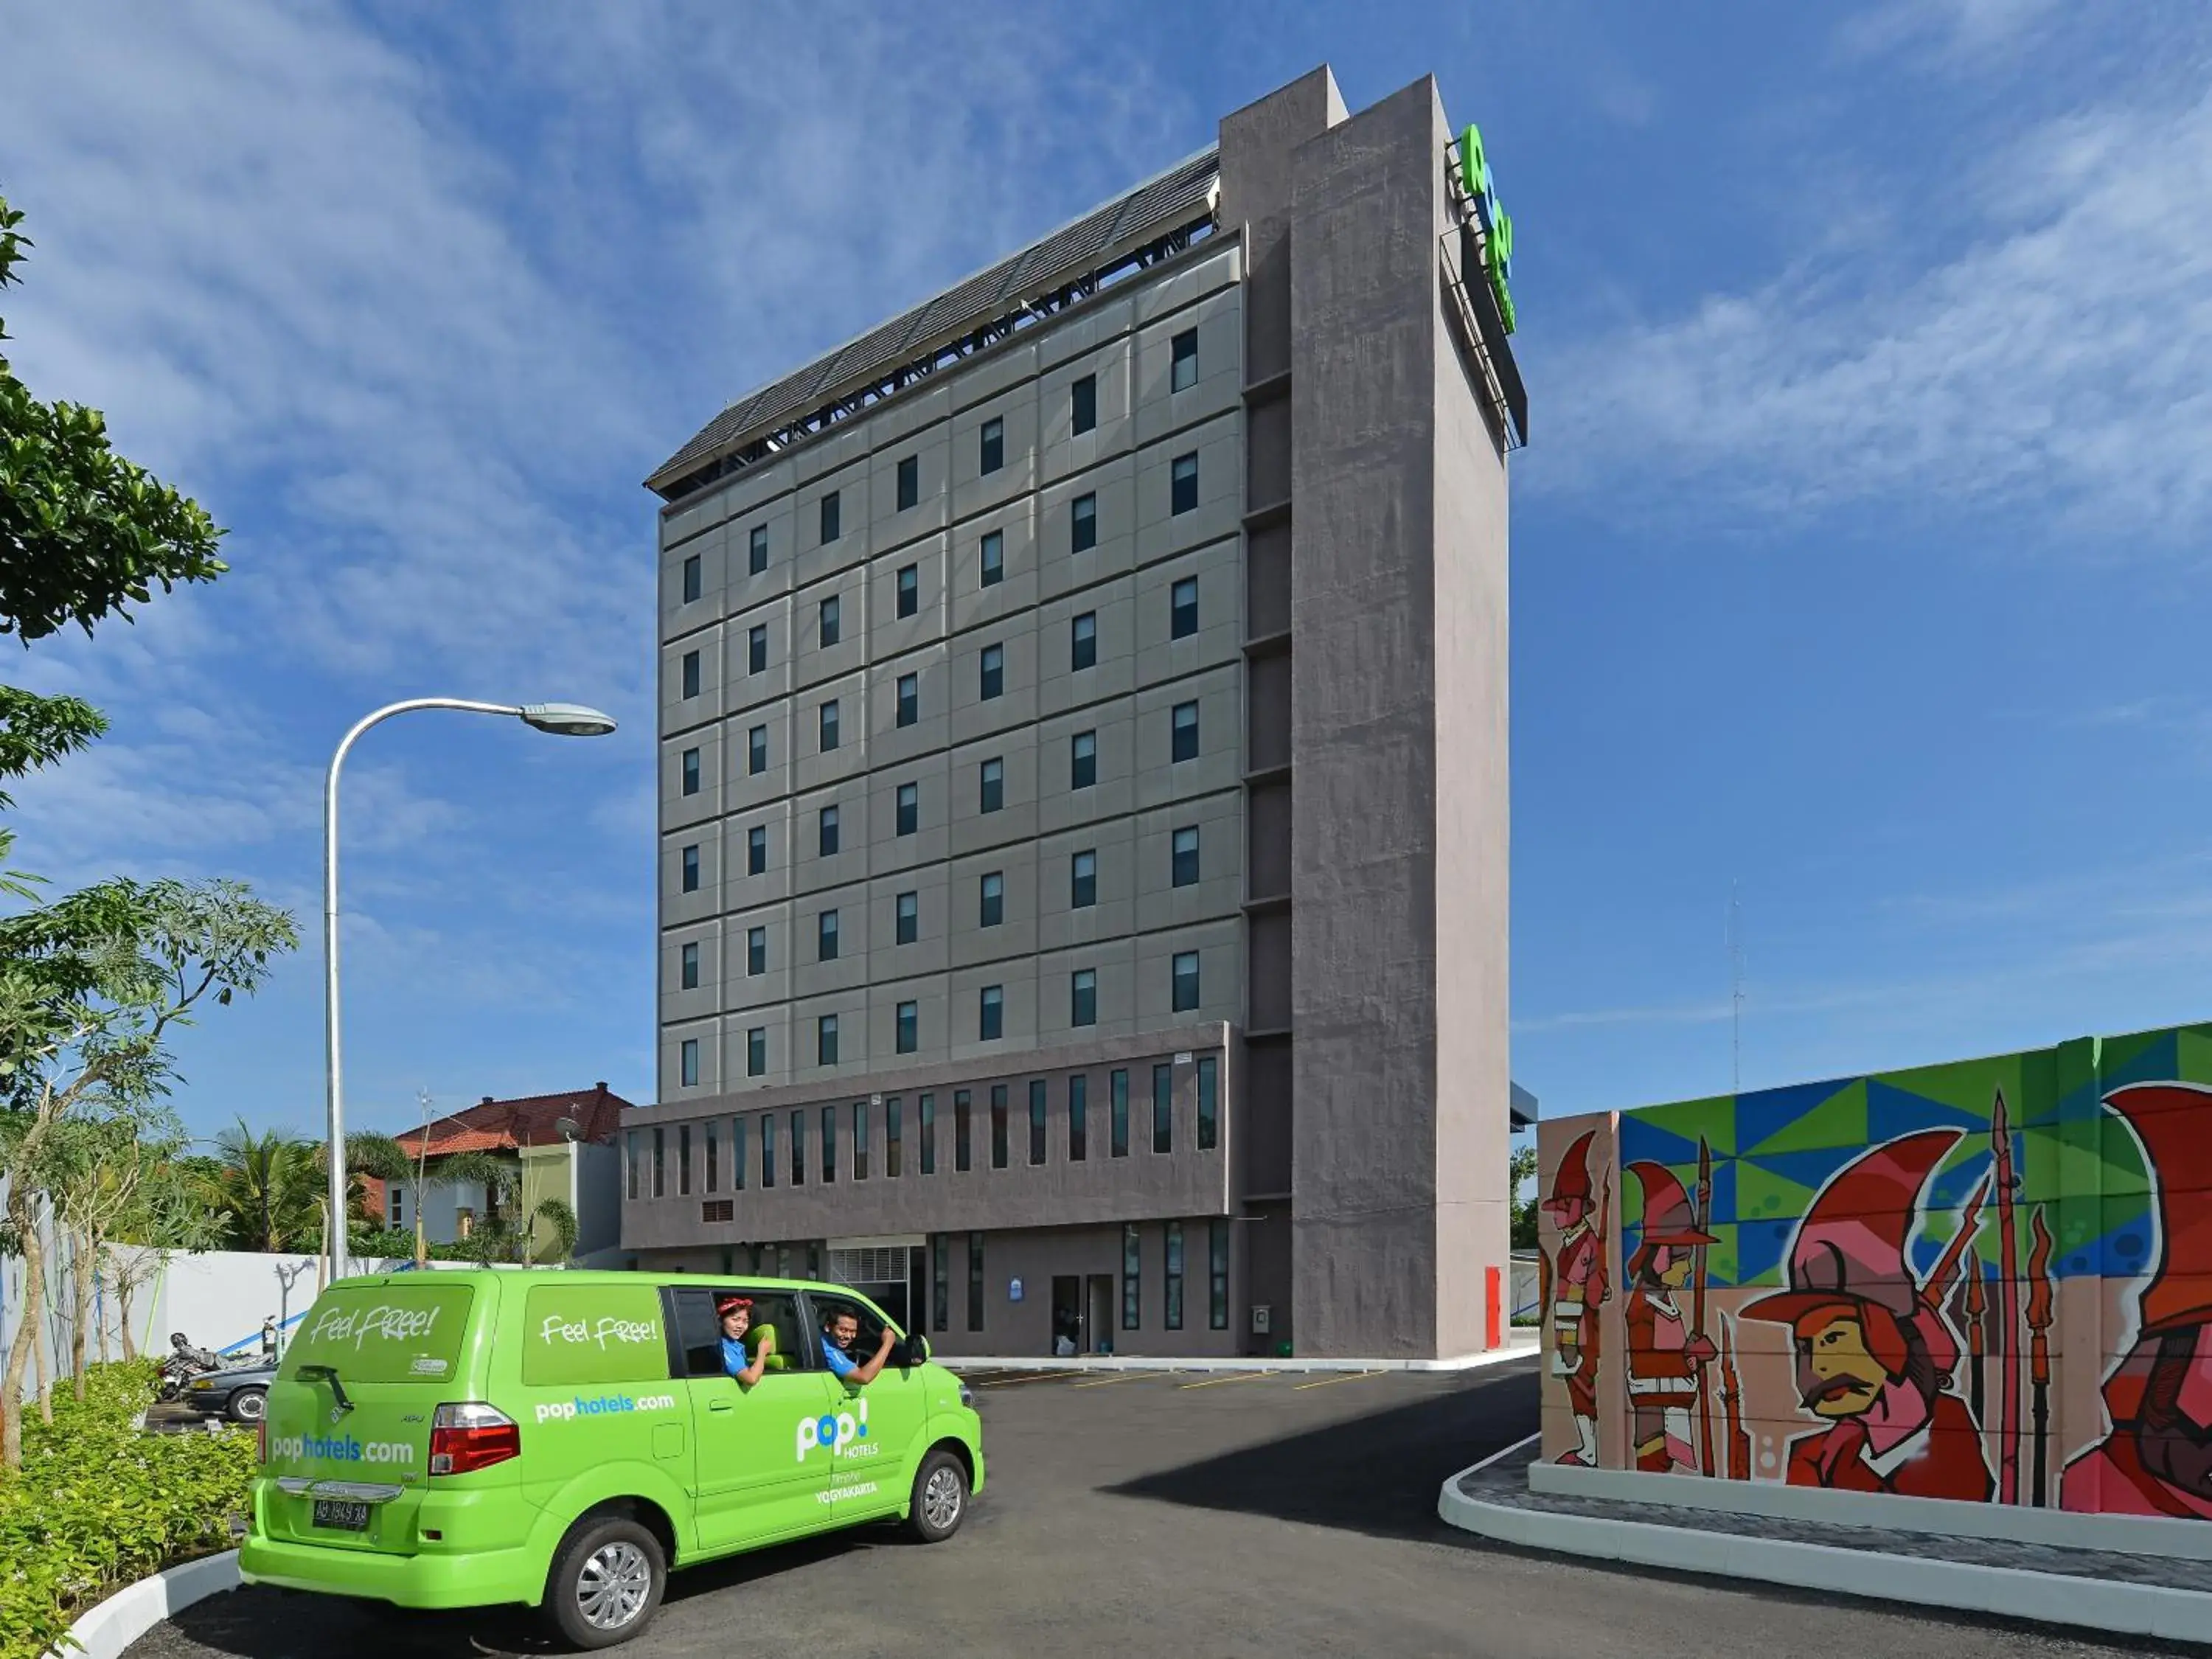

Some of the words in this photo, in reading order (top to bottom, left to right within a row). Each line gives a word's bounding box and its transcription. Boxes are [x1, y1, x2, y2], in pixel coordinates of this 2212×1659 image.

[310, 1307, 360, 1345] Feel
[539, 1315, 589, 1345] Feel
[535, 1393, 675, 1424] pophotels.com
[797, 1397, 869, 1462] pop!
[272, 1432, 414, 1464] pophotels.com
[844, 1442, 879, 1459] HOTELS
[815, 1481, 877, 1504] YOGYAKARTA
